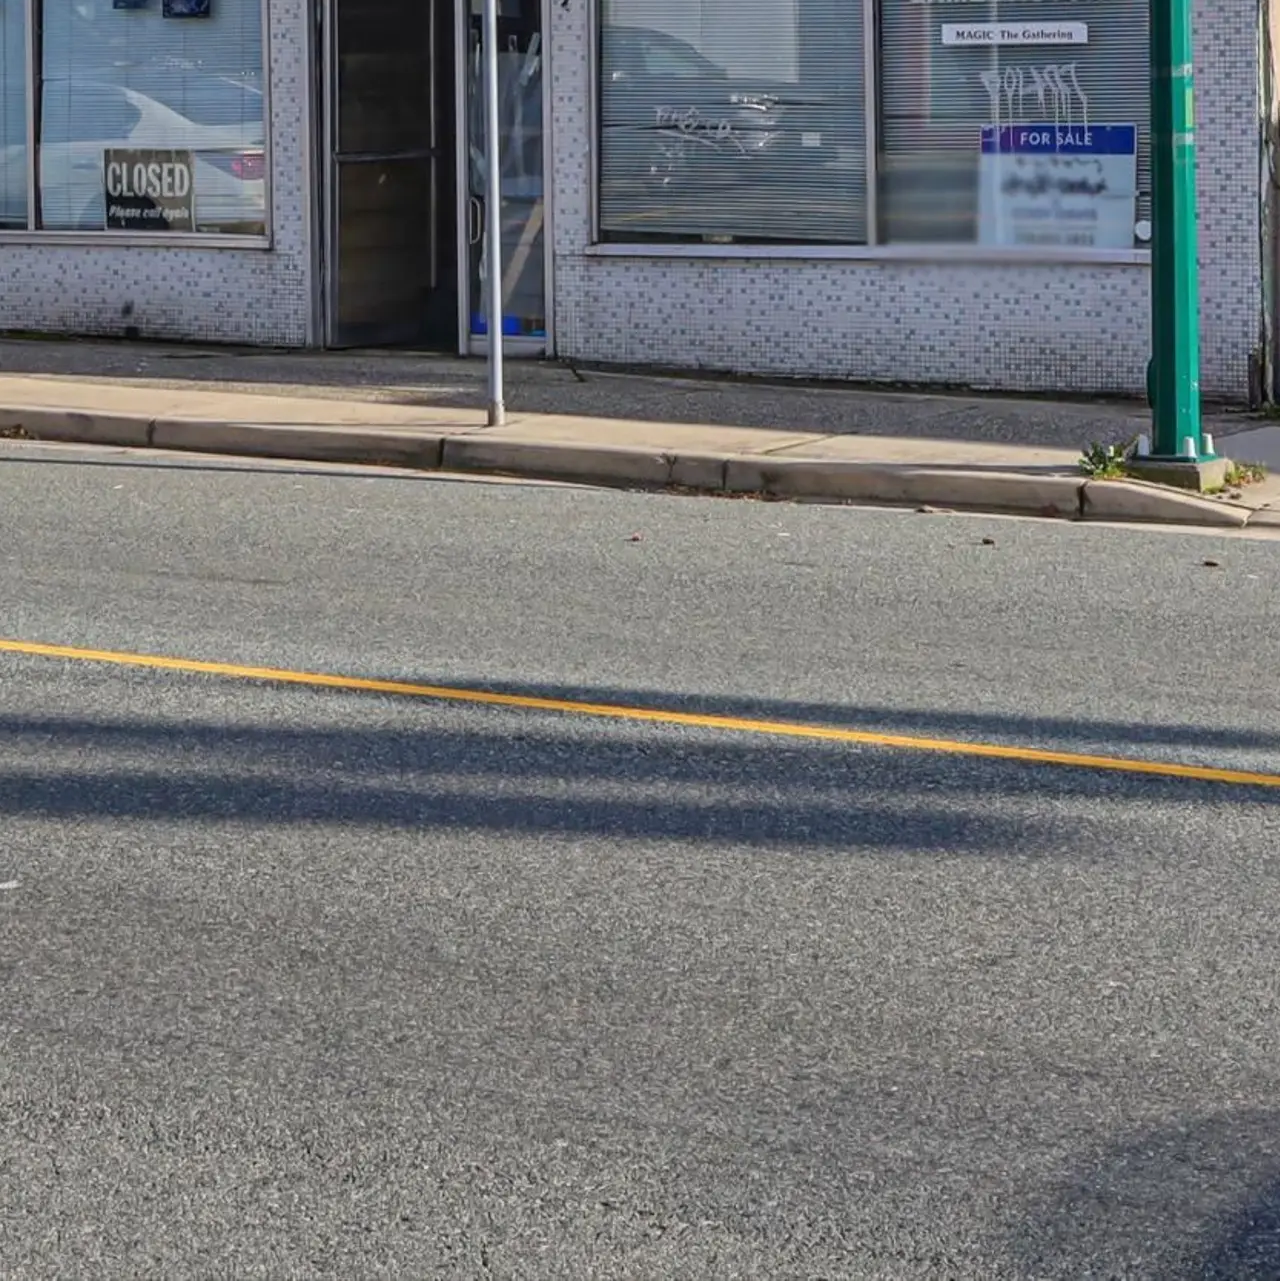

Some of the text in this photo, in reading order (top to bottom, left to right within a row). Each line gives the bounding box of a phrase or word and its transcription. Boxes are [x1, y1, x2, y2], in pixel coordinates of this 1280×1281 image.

[1000, 29, 1019, 40] The
[1022, 28, 1074, 41] Gathering
[1020, 131, 1093, 146] FOR SALE
[106, 161, 190, 198] CLOSED
